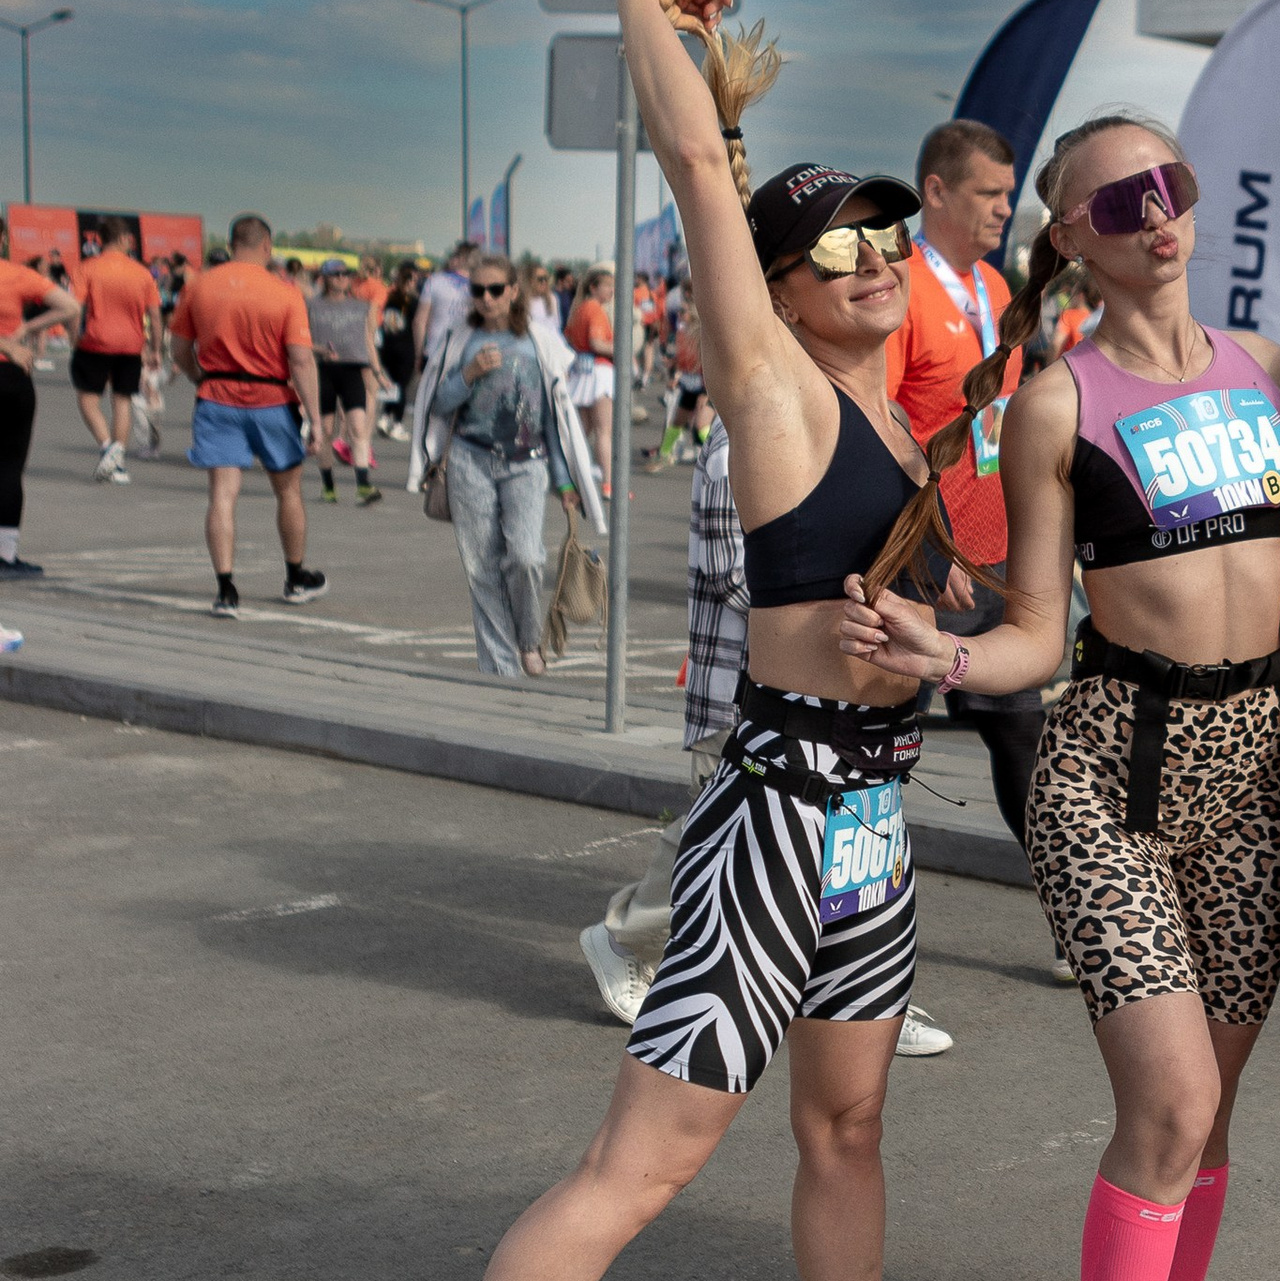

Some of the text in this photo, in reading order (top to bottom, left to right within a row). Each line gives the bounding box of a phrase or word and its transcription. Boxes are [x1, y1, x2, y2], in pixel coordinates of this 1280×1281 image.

[1227, 170, 1272, 330] RUM
[1140, 417, 1163, 432] ПСБ
[1213, 478, 1265, 513] 10KM
[1266, 476, 1280, 496] B
[1205, 513, 1245, 539] PRO
[858, 878, 887, 913] 10KM
